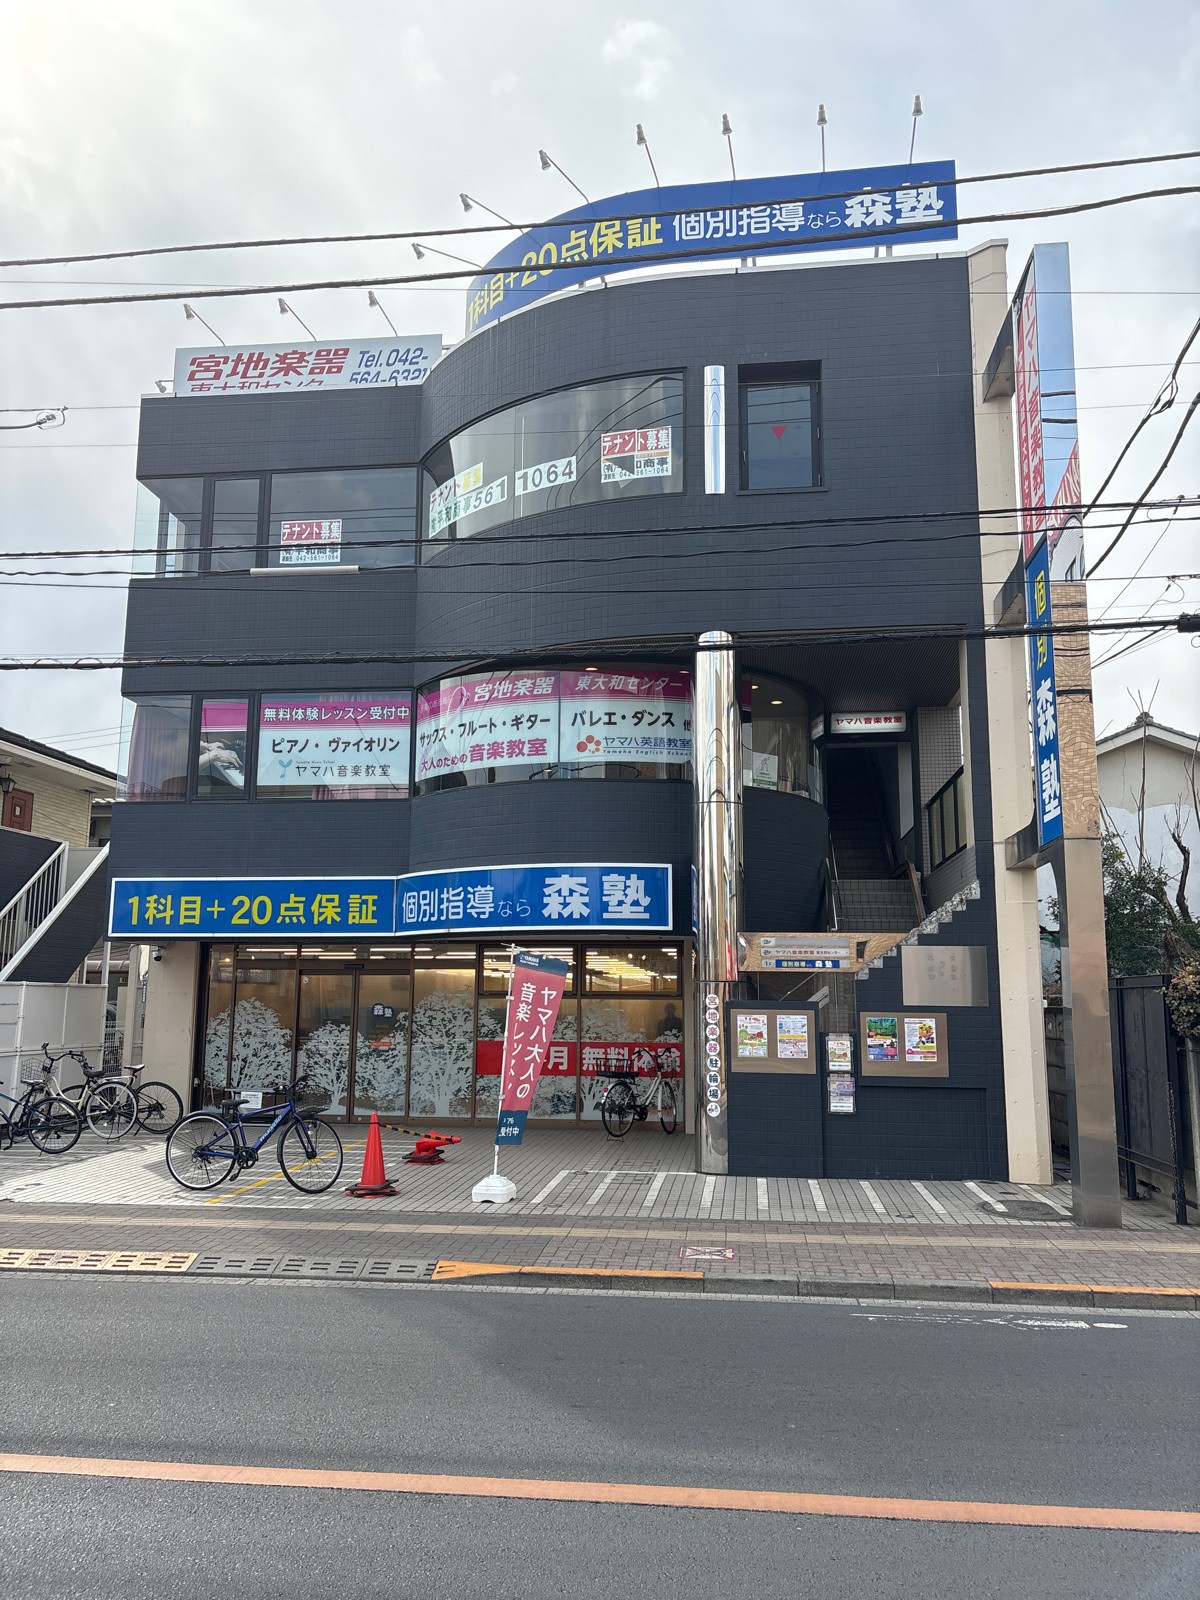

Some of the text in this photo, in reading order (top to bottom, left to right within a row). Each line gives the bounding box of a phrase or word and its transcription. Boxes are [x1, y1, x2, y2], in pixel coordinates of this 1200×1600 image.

[672, 182, 945, 242] 個別指導なら森塾
[187, 347, 350, 382] 宮地楽器
[602, 428, 669, 455] テナント募集
[473, 478, 505, 510] 561
[517, 459, 574, 492] 1064
[282, 521, 340, 541] テナント募集
[473, 676, 555, 703] 宮地楽器
[575, 674, 683, 692] 東大和センター
[263, 705, 410, 722] 無料体験レッスン受付中
[571, 709, 675, 728] バレエ・ダンス
[834, 715, 903, 725] ヤマハ音楽教室
[419, 712, 551, 748] サックス・フルート・ギター
[602, 736, 692, 748] ヤマハ英語教室
[271, 736, 401, 754] ピアノ・ヴァイオリン
[420, 737, 548, 773] 大人のための音楽教室
[295, 764, 391, 777] ヤマハ音楽教室
[127, 873, 652, 925] 1科目+20点保証 個別指導なら森塾
[373, 1004, 393, 1018] 森塾
[517, 986, 558, 1100] ヤマハ大人の
[707, 995, 720, 1100] 宮地楽器駐輪場
[544, 1047, 569, 1070] 月
